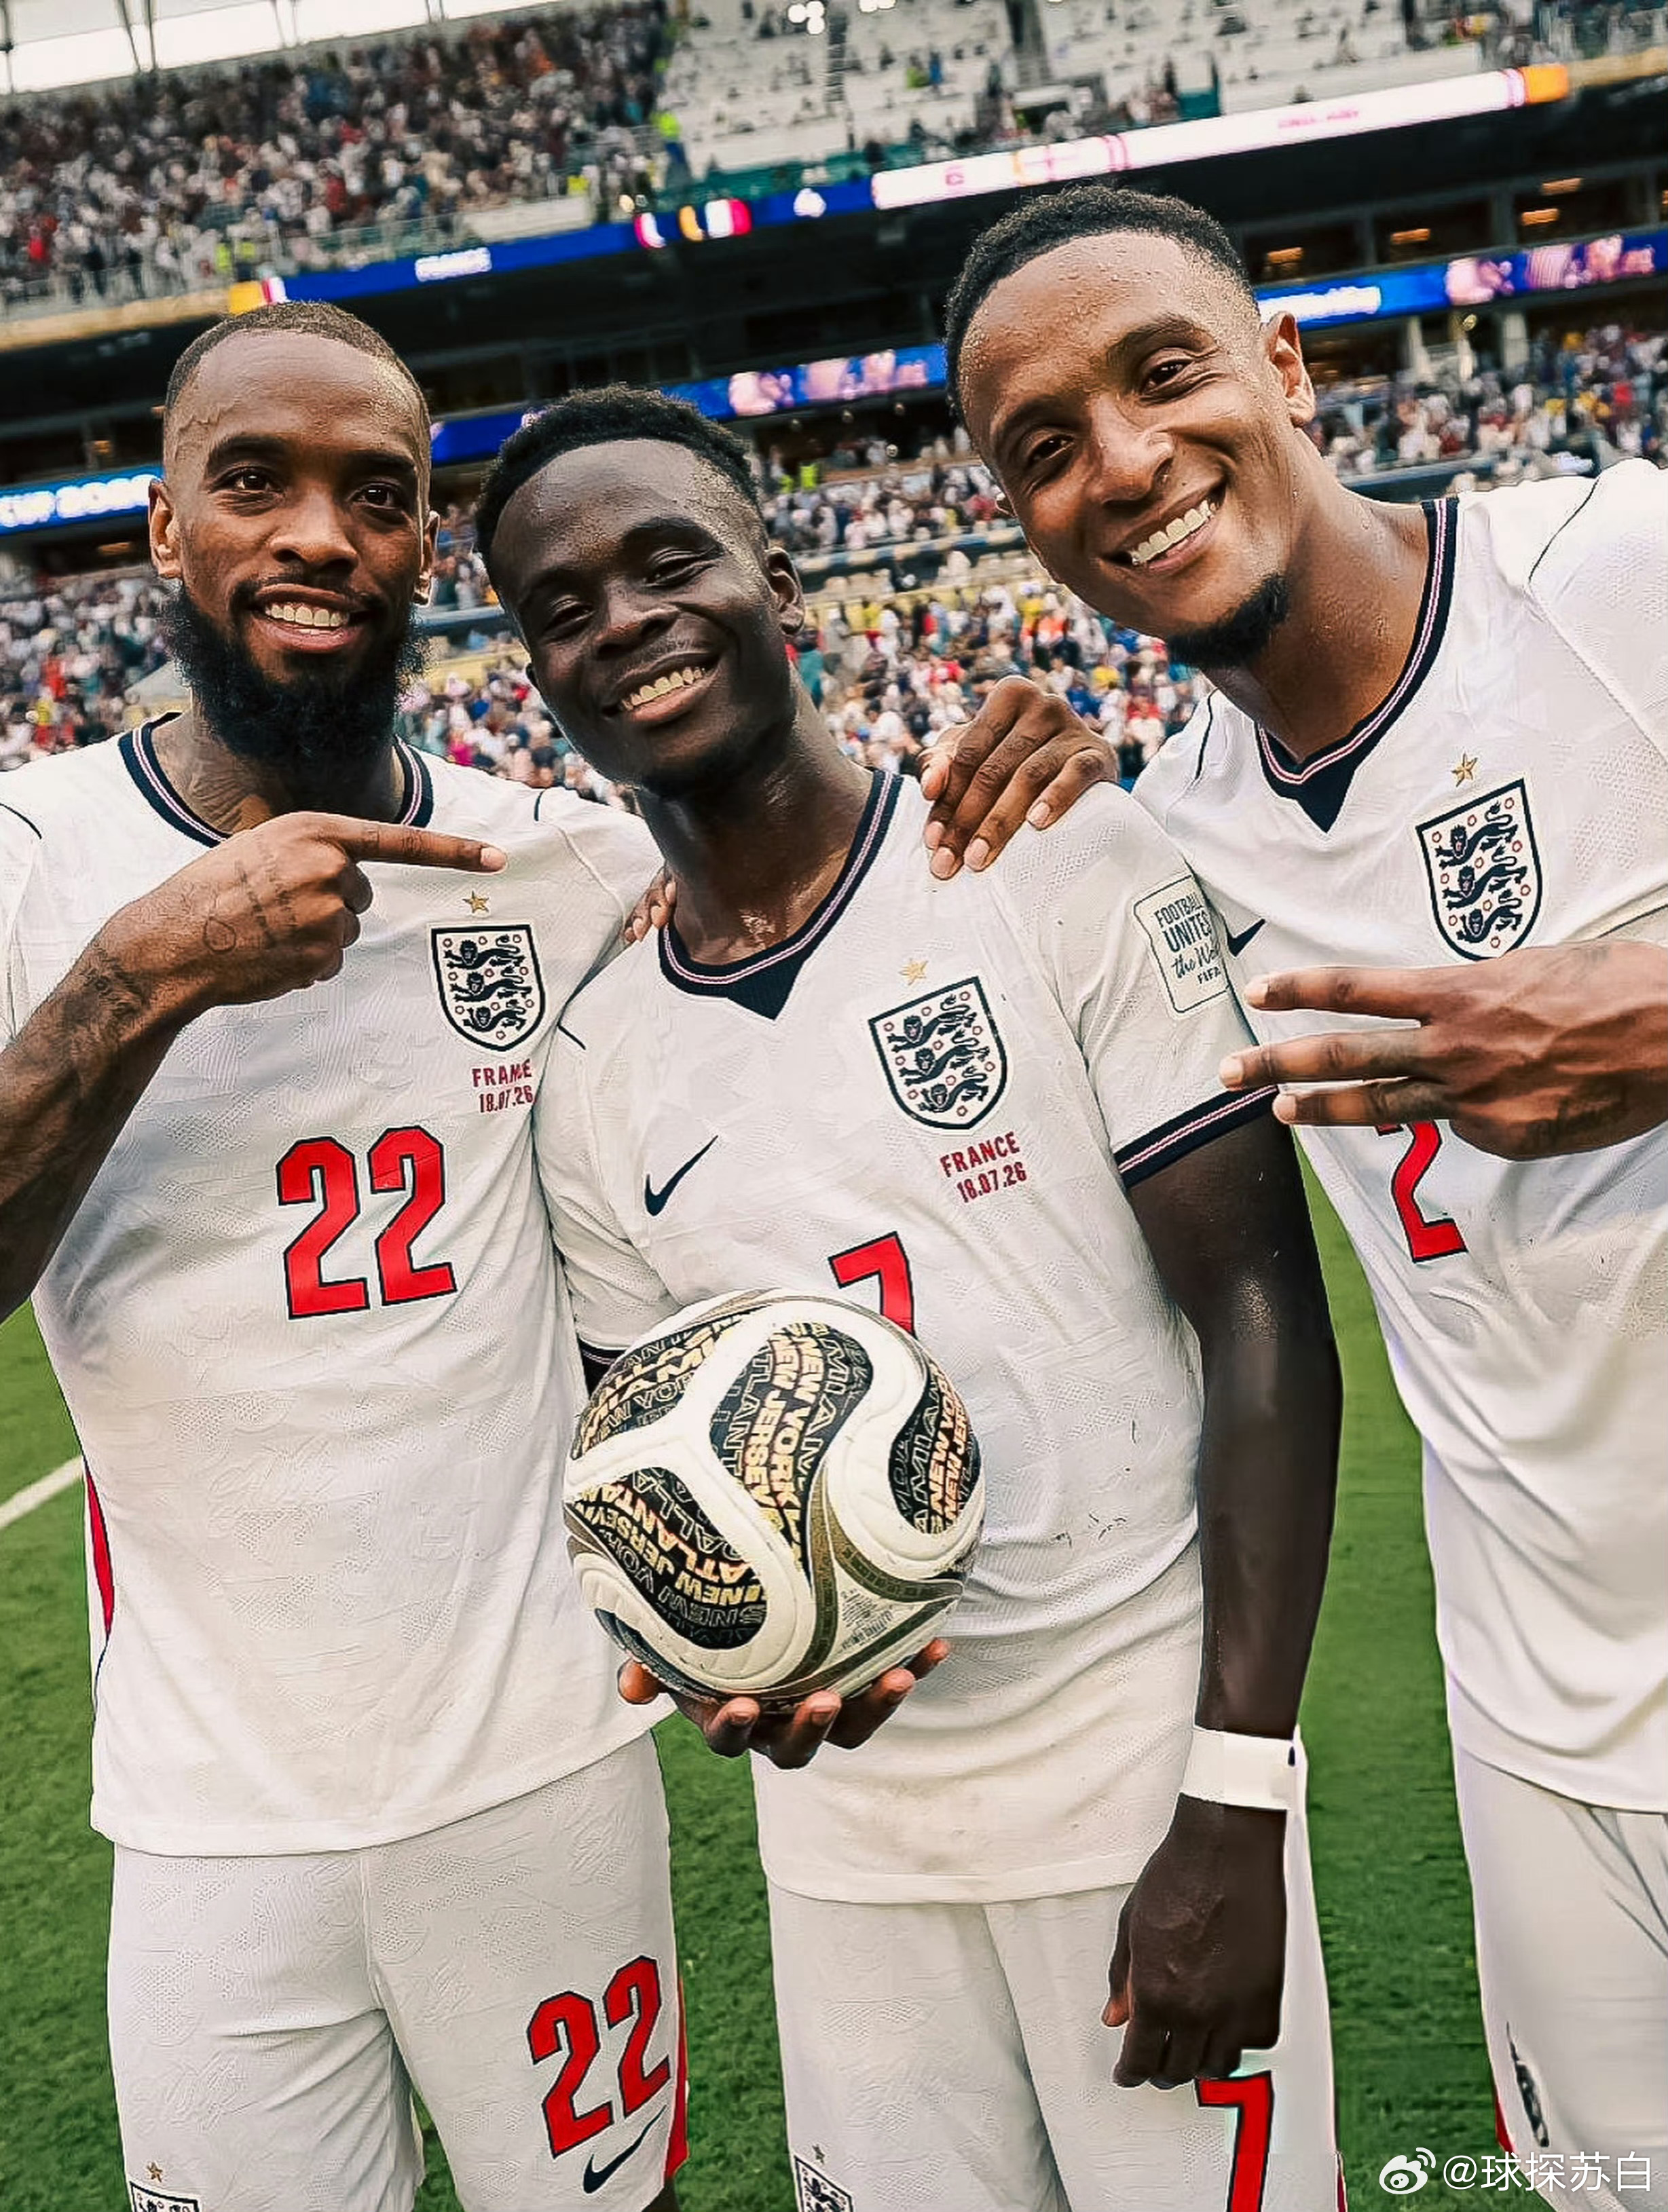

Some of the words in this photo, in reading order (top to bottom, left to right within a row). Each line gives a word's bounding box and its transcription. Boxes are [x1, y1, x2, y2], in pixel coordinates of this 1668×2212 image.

[1172, 953, 1196, 979] the
[940, 1131, 1020, 1177] FRANCE
[957, 1161, 1028, 1203] 18.07.26
[1375, 1119, 1468, 1263] 2
[276, 1125, 458, 1319] 22
[828, 1231, 917, 1341] 7
[791, 1336, 824, 1404] NEW
[743, 1390, 787, 1507] JERSEY
[768, 1406, 811, 1508] YORK
[526, 1955, 671, 2159] 22
[1195, 2070, 1274, 2212] 7
